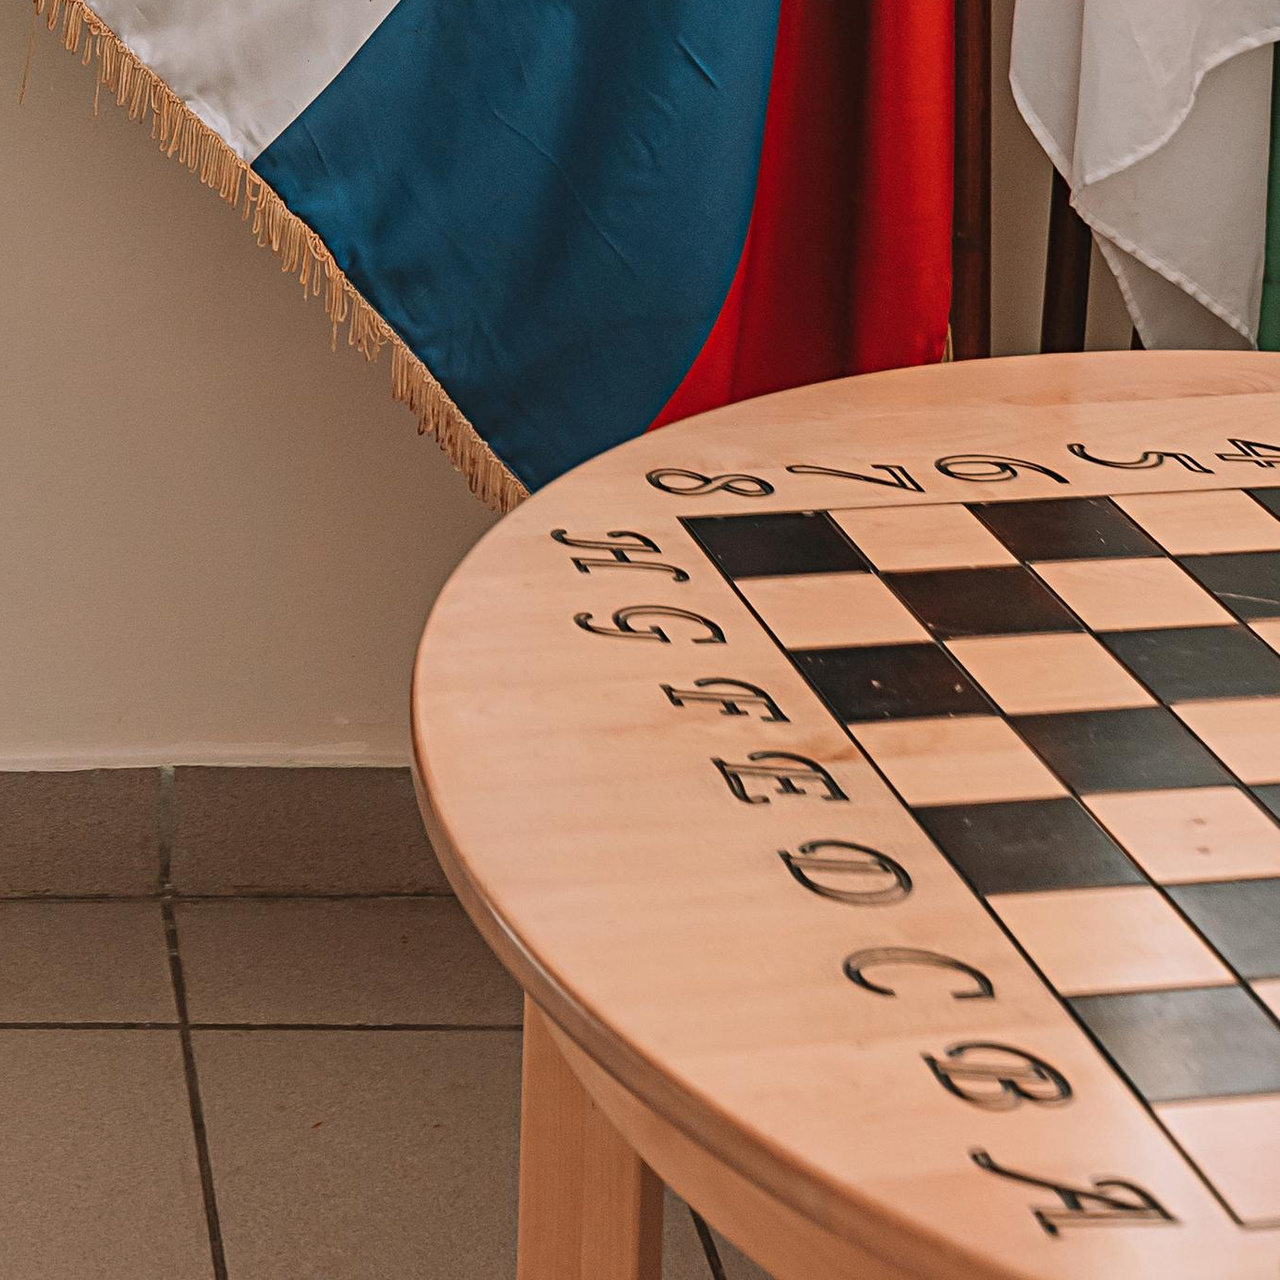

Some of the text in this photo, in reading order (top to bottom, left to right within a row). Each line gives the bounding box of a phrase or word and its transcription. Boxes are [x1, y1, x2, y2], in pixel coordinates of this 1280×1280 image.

[646, 467, 774, 497] 8
[786, 465, 926, 493] 7
[933, 453, 1071, 485] 6
[1067, 442, 1215, 475] 5
[550, 528, 1178, 1238] H G F E D C B A
